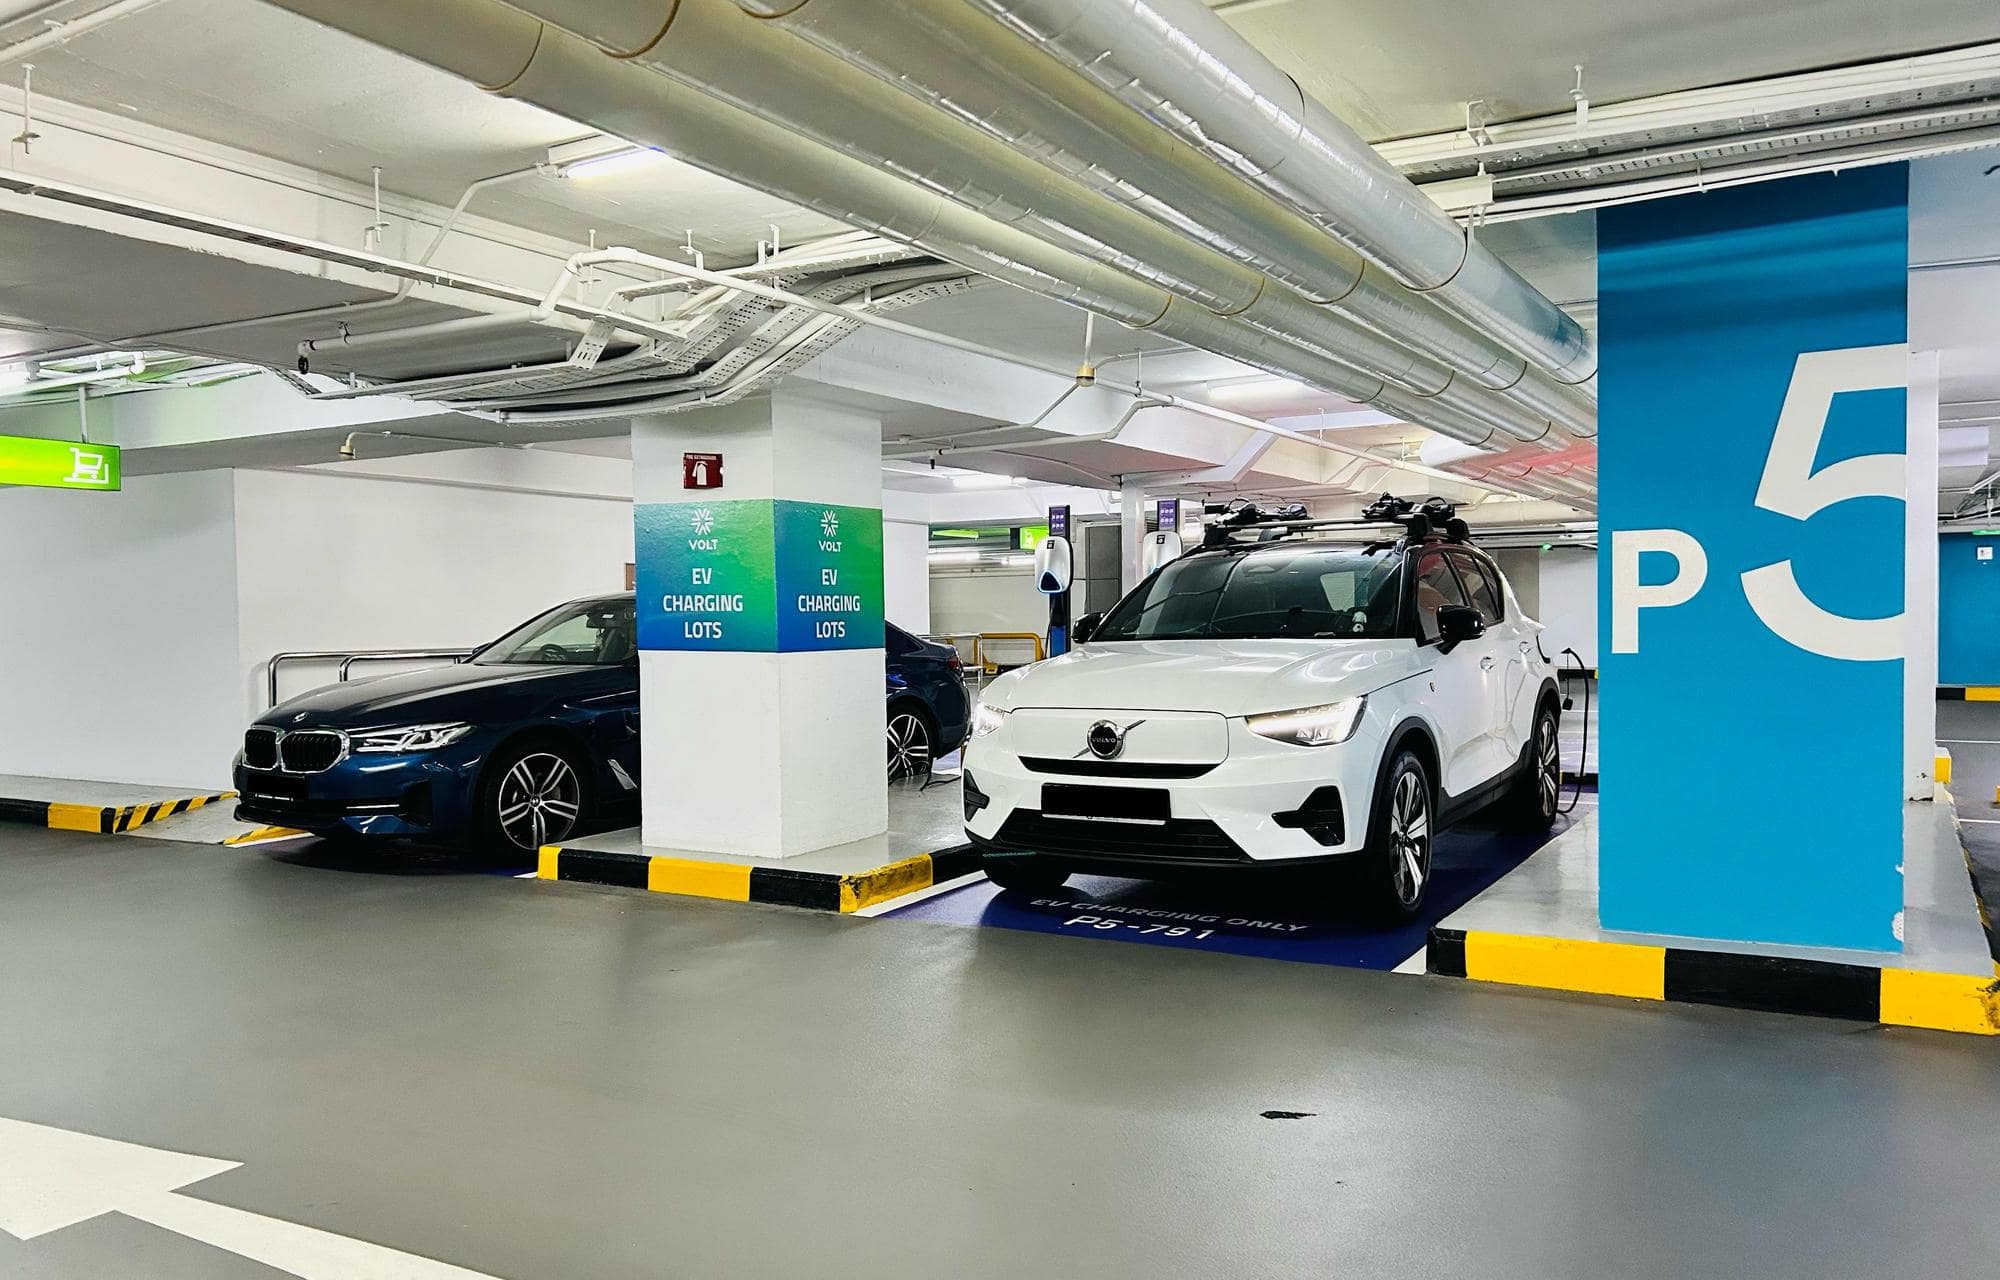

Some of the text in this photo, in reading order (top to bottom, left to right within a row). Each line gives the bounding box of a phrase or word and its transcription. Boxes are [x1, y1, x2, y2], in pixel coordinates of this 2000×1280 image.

[689, 539, 718, 551] VOLT
[818, 540, 842, 552] VOLT
[692, 568, 712, 585] EV
[822, 569, 838, 586] EV
[663, 595, 743, 612] CHARGING
[798, 595, 861, 612] CHARGING
[684, 622, 722, 639] LOTS
[816, 621, 846, 638] LOTS
[1030, 899, 1308, 932] EV CHARGING ONLY
